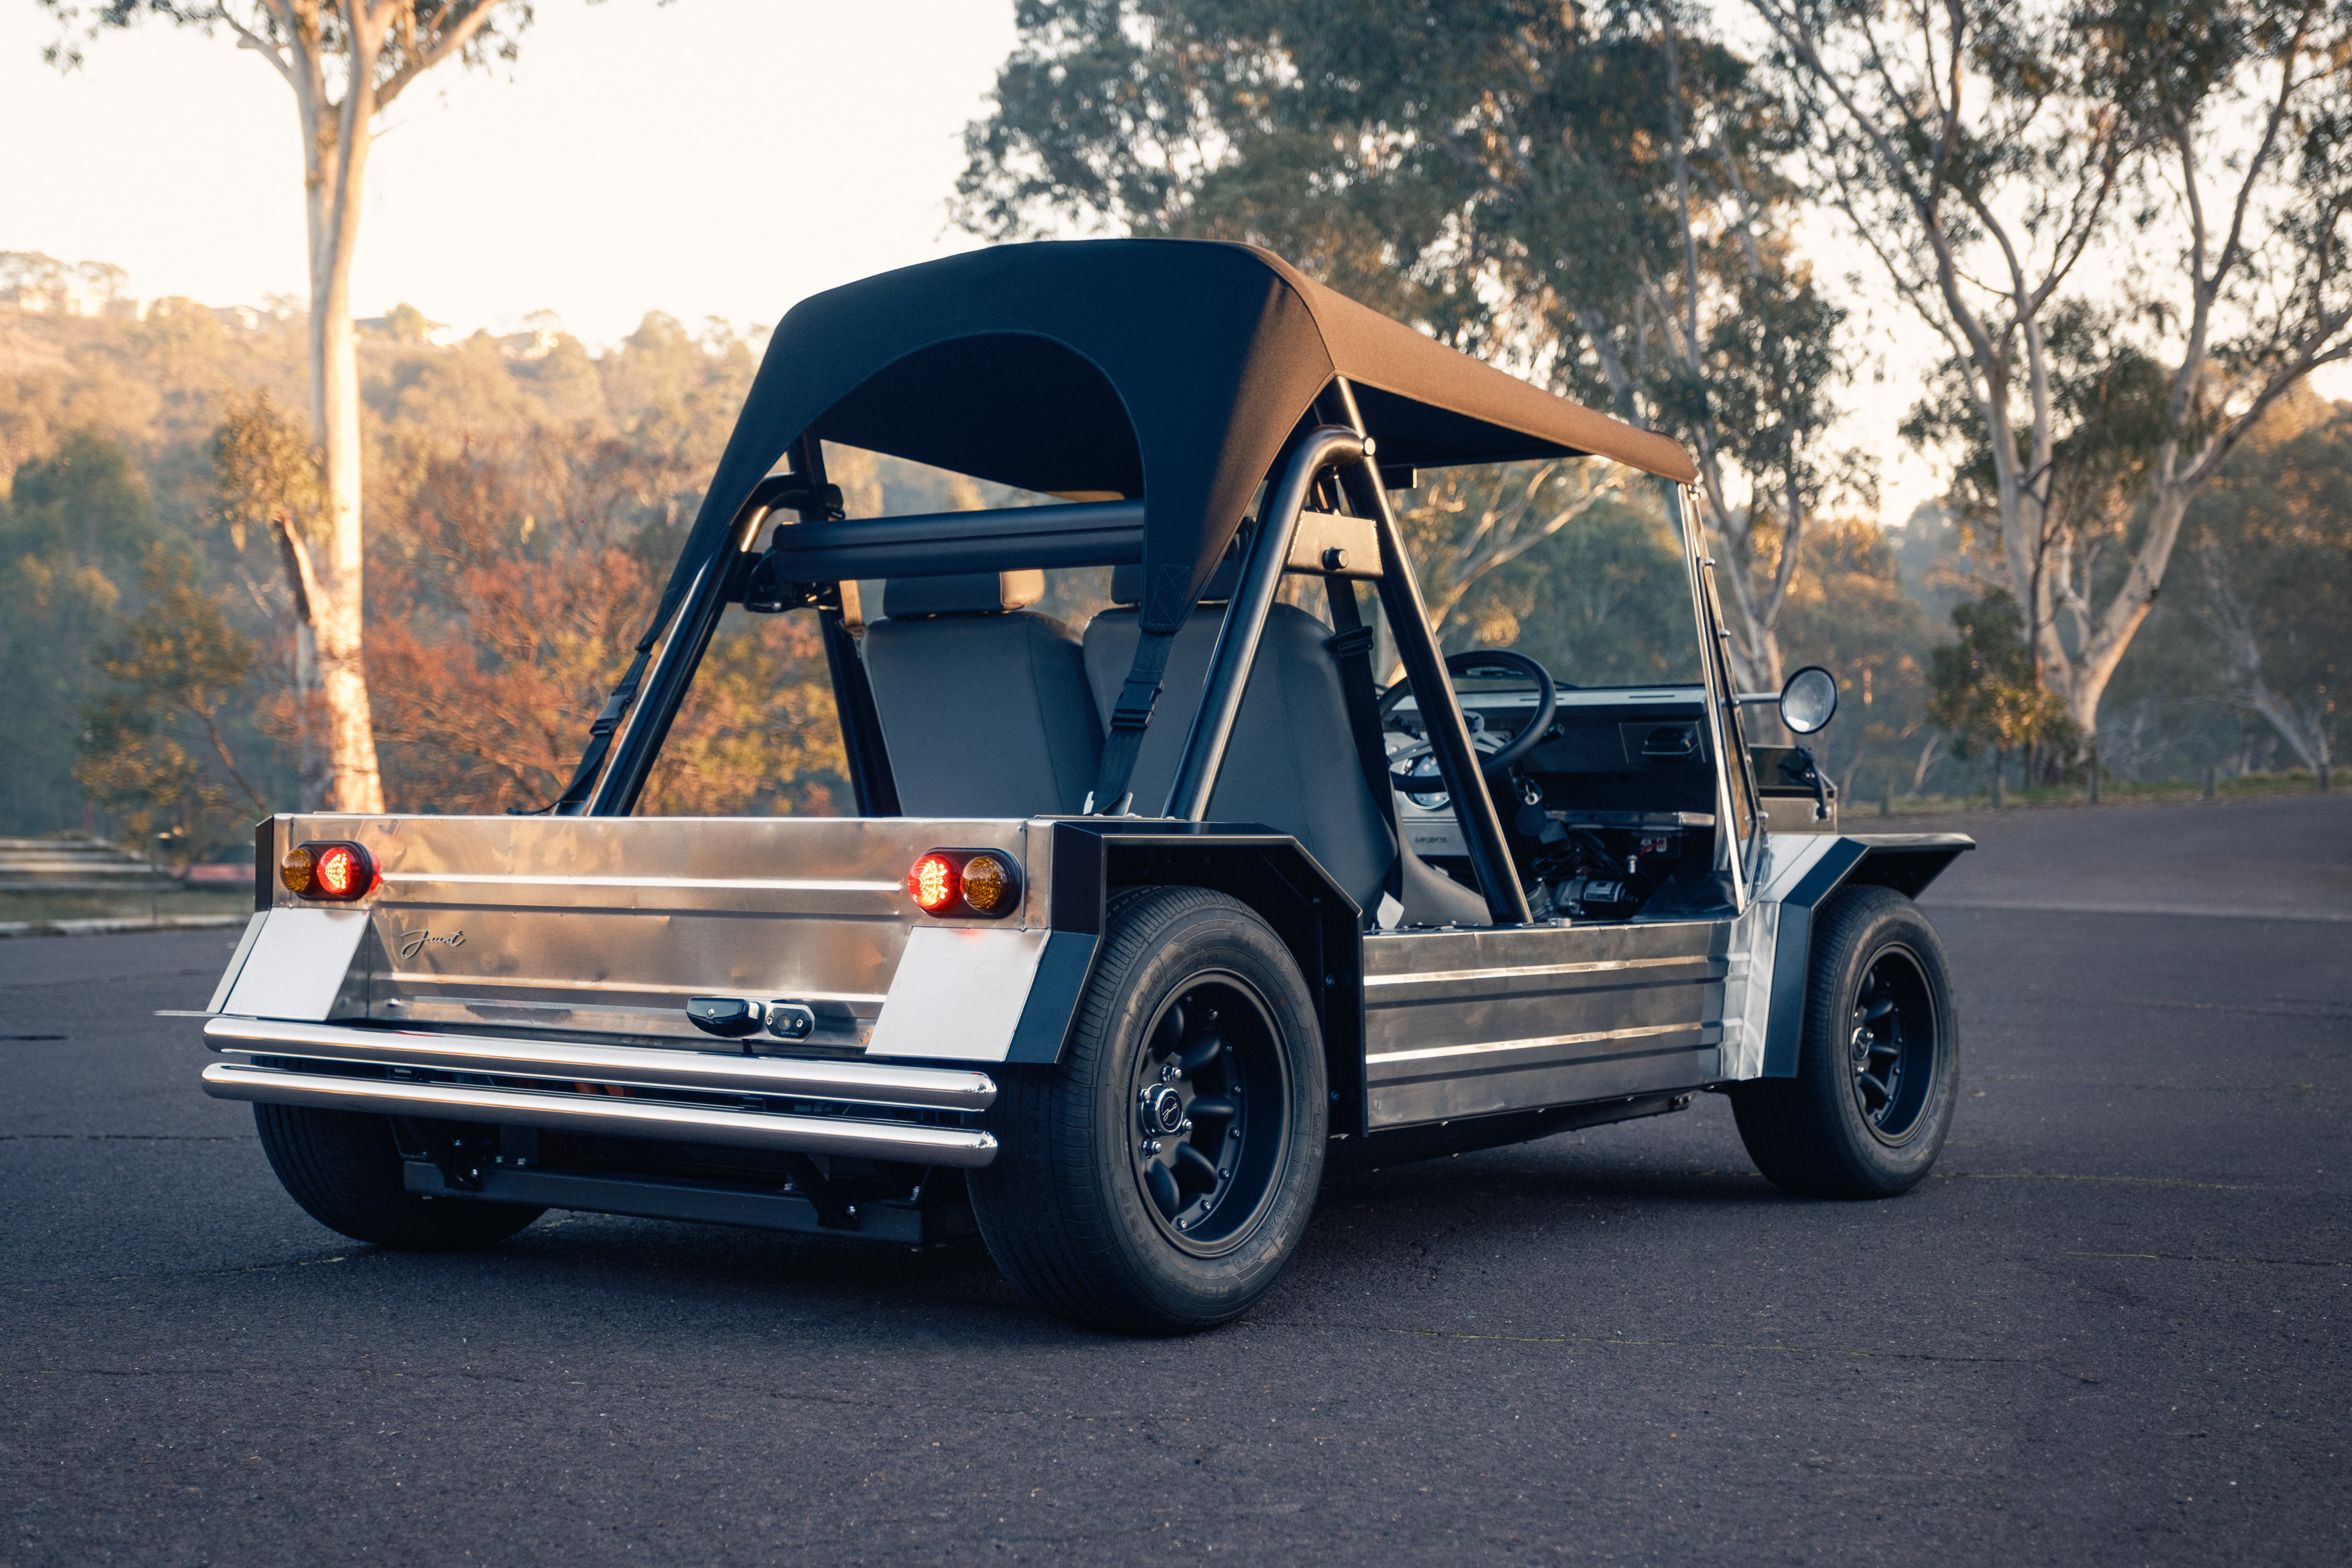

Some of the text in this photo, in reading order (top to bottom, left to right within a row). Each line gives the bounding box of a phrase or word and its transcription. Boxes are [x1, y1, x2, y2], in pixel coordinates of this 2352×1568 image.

[400, 928, 466, 959] Jaunt
[1257, 940, 1306, 1010] NANKANG
[1288, 1156, 1299, 1185] RADIAL
[1241, 1197, 1288, 1262] 205/60R13 86H
[1168, 1273, 1229, 1298] REMEX
